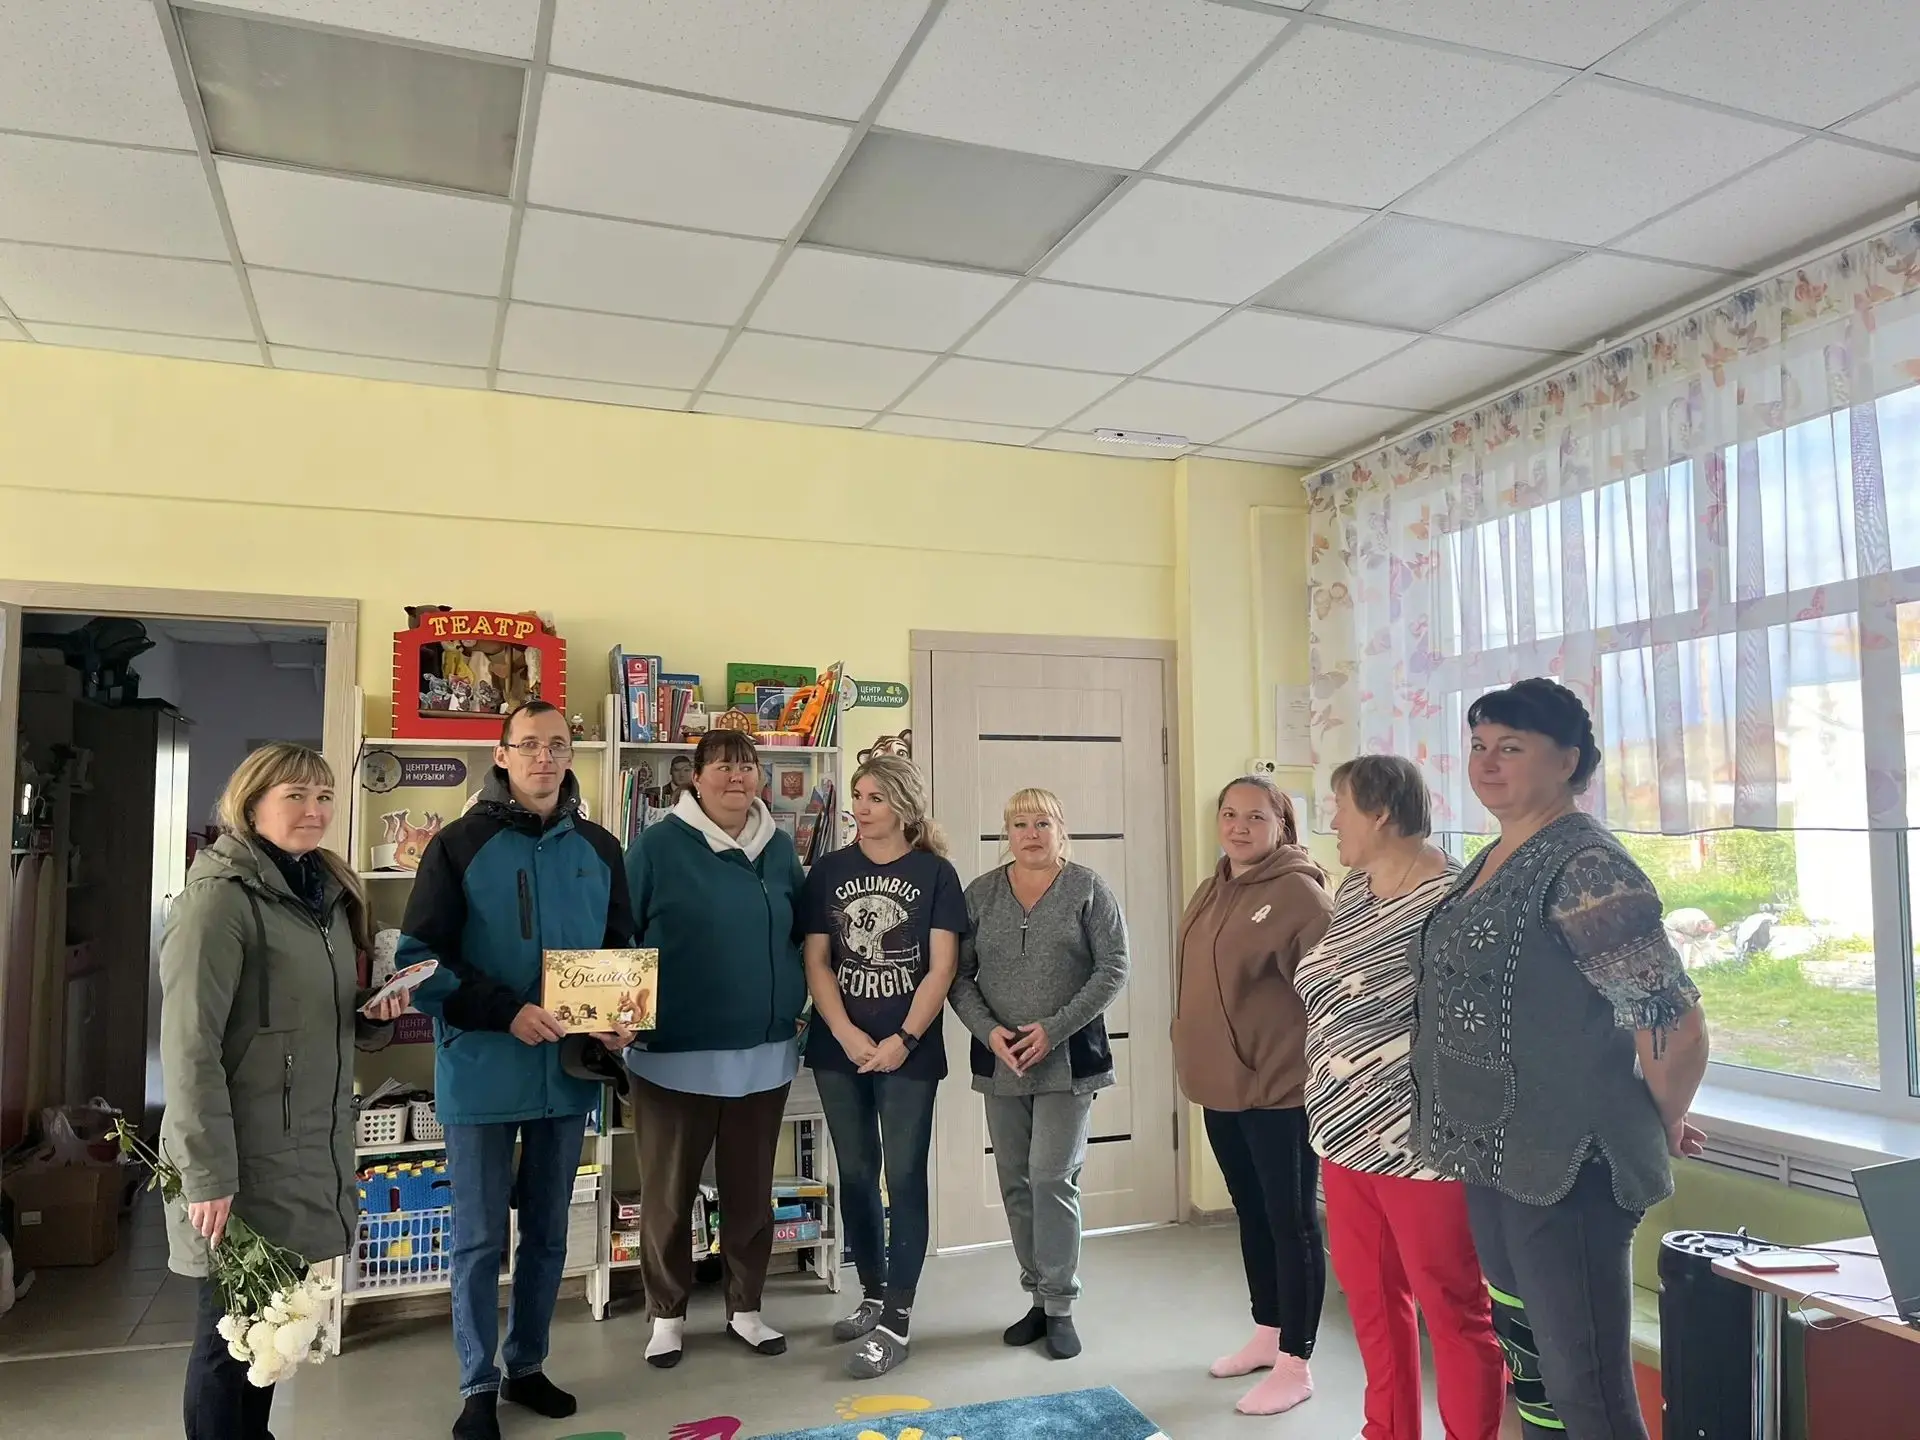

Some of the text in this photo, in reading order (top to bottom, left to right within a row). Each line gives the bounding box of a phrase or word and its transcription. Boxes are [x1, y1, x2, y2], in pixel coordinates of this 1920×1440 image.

[428, 615, 535, 639] ТЕАТР
[860, 686, 881, 694] ЦЕНТР
[860, 695, 904, 703] МАТЕМАТИКИ
[405, 763, 457, 772] ЦЕНТР ТЕАТРА
[405, 773, 445, 781] И МУЗЫКИ
[835, 875, 921, 902] COLUMBUS
[853, 908, 878, 932] 36
